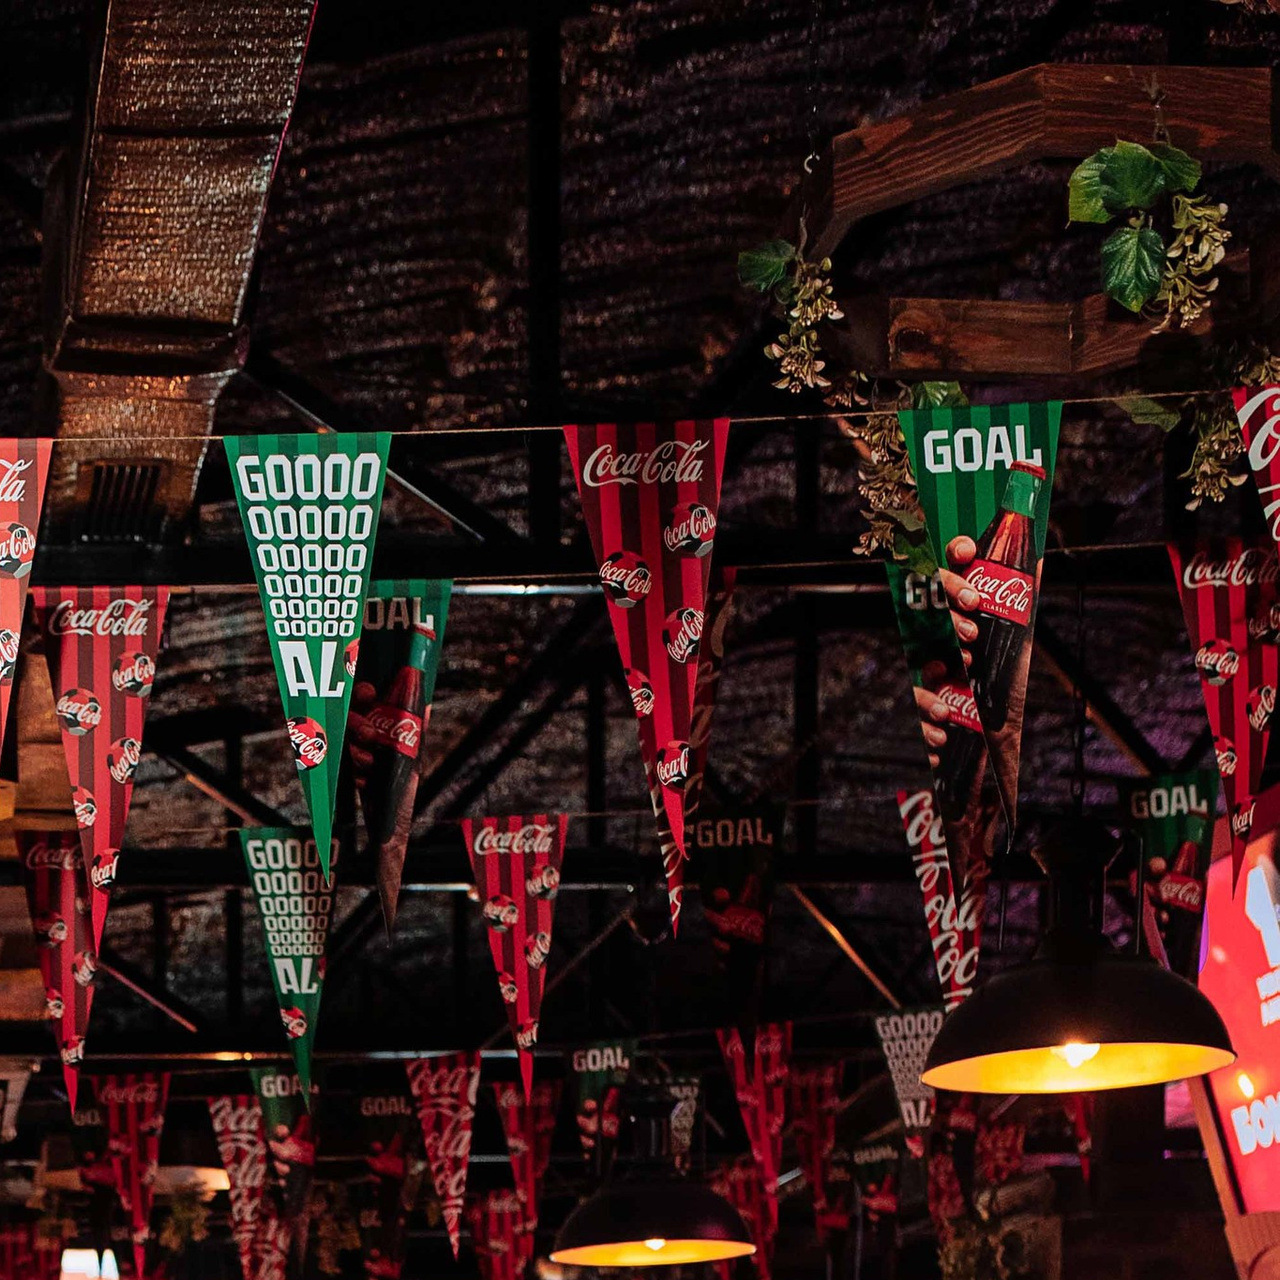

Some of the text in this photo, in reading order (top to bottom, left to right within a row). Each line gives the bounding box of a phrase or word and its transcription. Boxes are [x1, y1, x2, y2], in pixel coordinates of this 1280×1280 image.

[583, 440, 711, 488] Coca-Cola
[923, 425, 1042, 473] GOAL
[236, 453, 381, 501] GOOOO
[247, 505, 373, 540] OOOOO
[257, 544, 367, 572] OOOOO
[264, 574, 363, 598] OOOOO
[49, 599, 154, 636] Coca-Cola
[269, 599, 358, 619] OOOOO
[363, 597, 434, 630] OAL
[982, 602, 1010, 616] CLASSIC
[274, 619, 355, 637] OOOOO
[278, 641, 346, 698] AL
[1130, 784, 1208, 819] GOAL
[474, 824, 555, 856] Coca-Cola
[697, 818, 773, 848] GOAL
[273, 957, 318, 994] AL
[572, 1046, 630, 1073] GOAL
